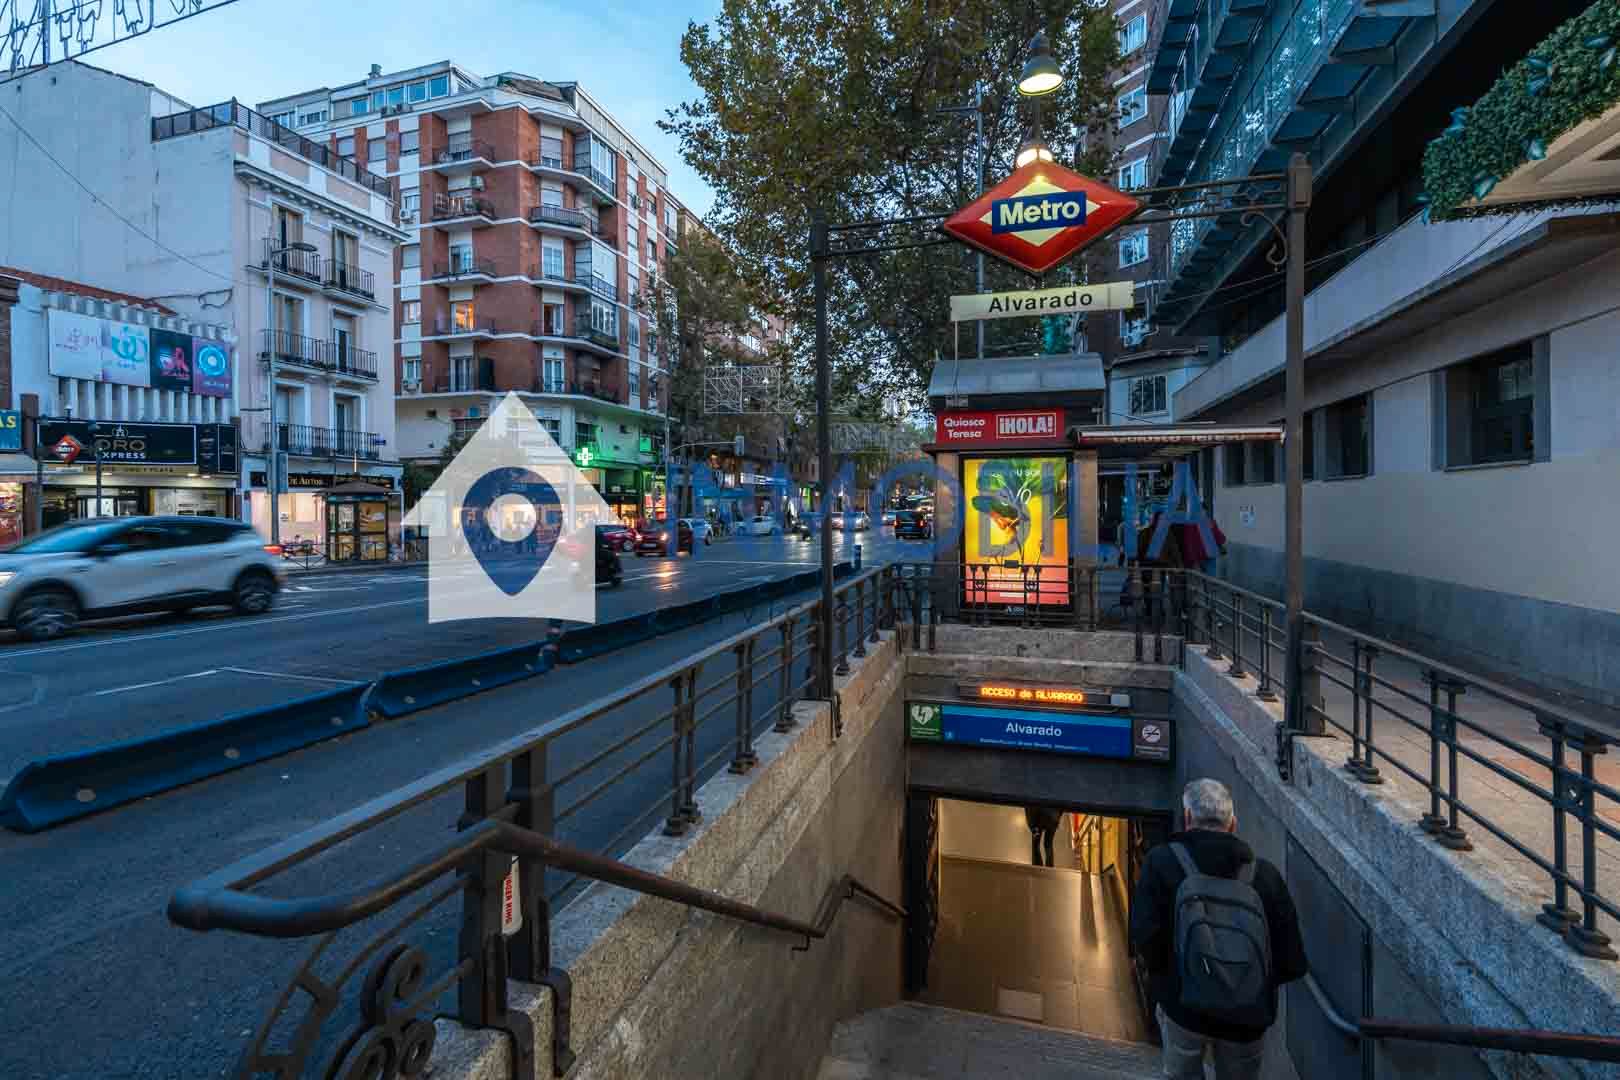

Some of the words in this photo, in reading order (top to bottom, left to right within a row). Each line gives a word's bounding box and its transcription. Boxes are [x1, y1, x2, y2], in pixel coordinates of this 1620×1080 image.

[1000, 200, 1080, 226] Metro
[988, 291, 1093, 312] Alvarado
[944, 417, 985, 428] Quiosco
[999, 415, 1053, 434] ¡HOLA!
[948, 429, 982, 439] Teresa
[95, 439, 145, 451] ORO
[97, 451, 146, 460] XPRESS
[981, 687, 1016, 697] ACCESO
[1019, 688, 1032, 699] de
[1035, 690, 1083, 702] ALVARADO
[1005, 721, 1062, 737] Alvarado
